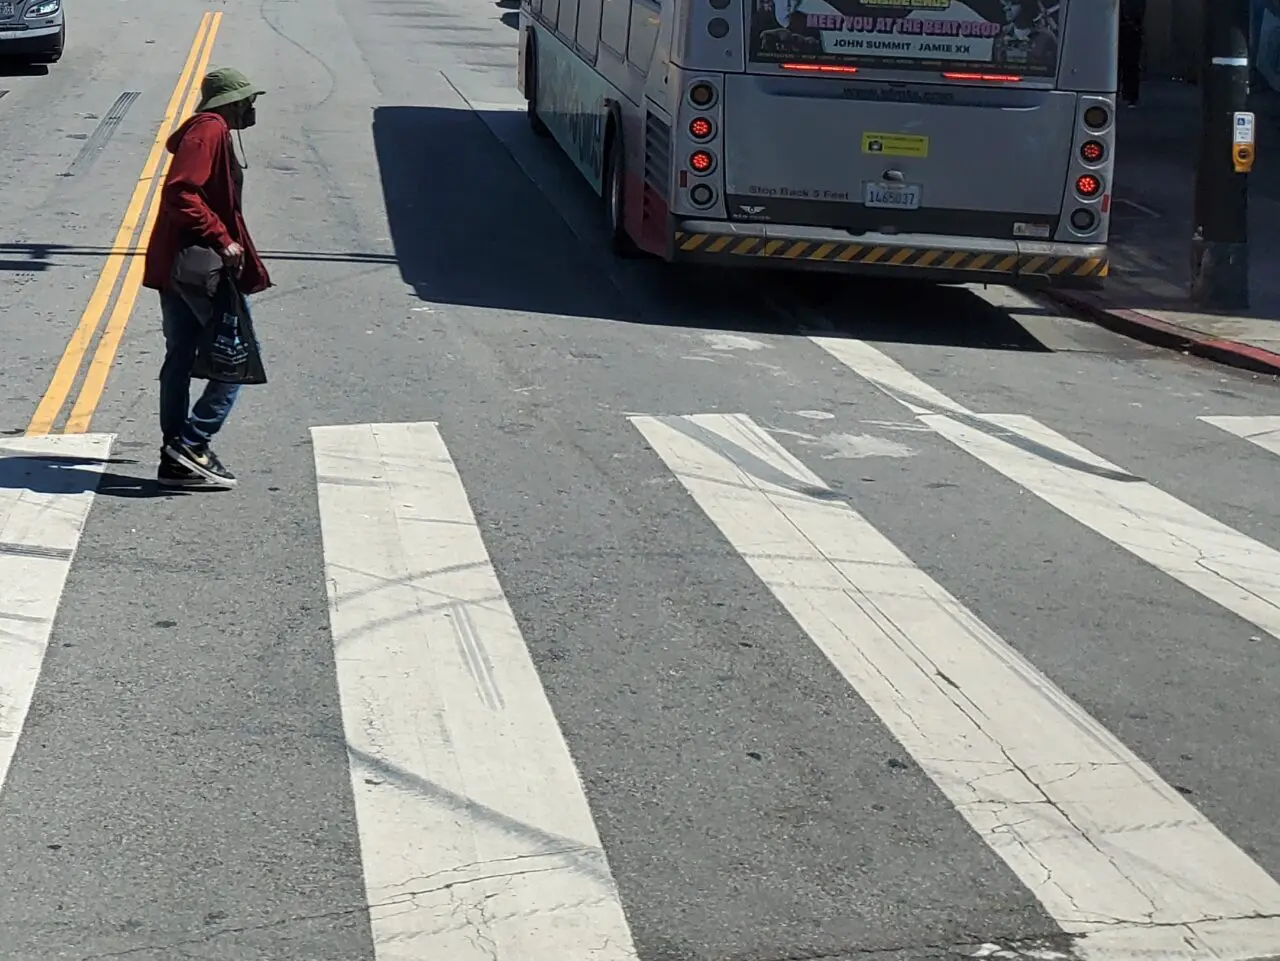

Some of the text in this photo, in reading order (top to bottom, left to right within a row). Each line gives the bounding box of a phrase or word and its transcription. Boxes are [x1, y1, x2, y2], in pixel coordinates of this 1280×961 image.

[807, 13, 1001, 38] MEET YOU AT THE BEAT DROP
[833, 38, 971, 54] JOHN SUMMIT JAMIE XX
[749, 185, 849, 200] Stop Back 5 Feet
[868, 192, 915, 206] 1465037
